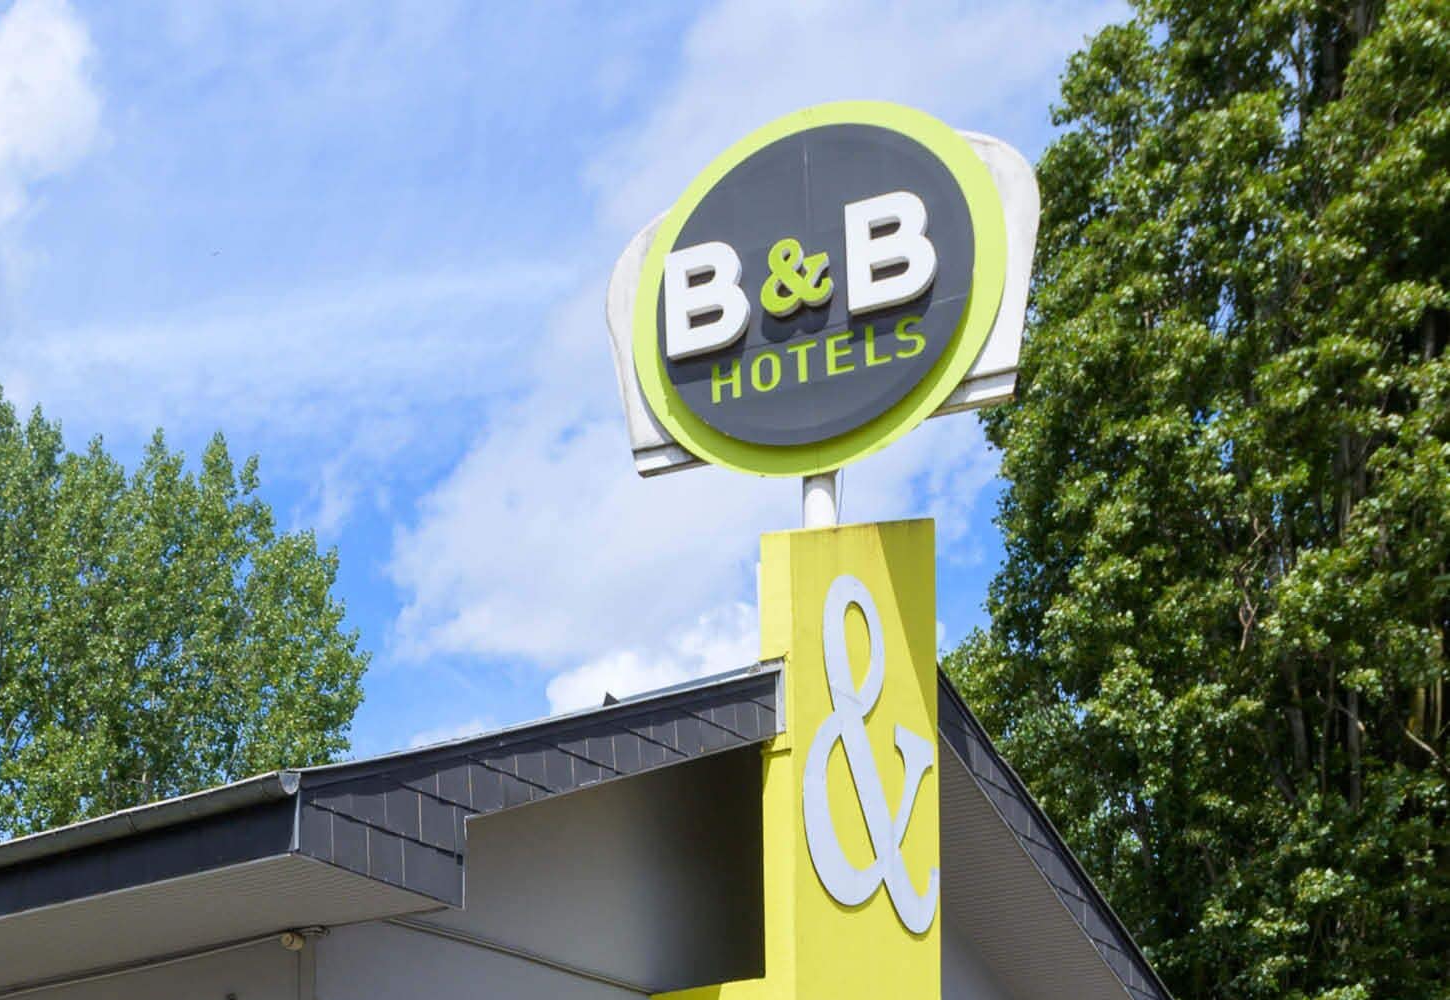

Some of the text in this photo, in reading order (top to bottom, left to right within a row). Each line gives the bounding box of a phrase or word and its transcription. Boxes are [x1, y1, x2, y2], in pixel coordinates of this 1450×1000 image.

[664, 191, 938, 360] B&B
[711, 315, 927, 404] HOTELS
[803, 574, 941, 935] &
